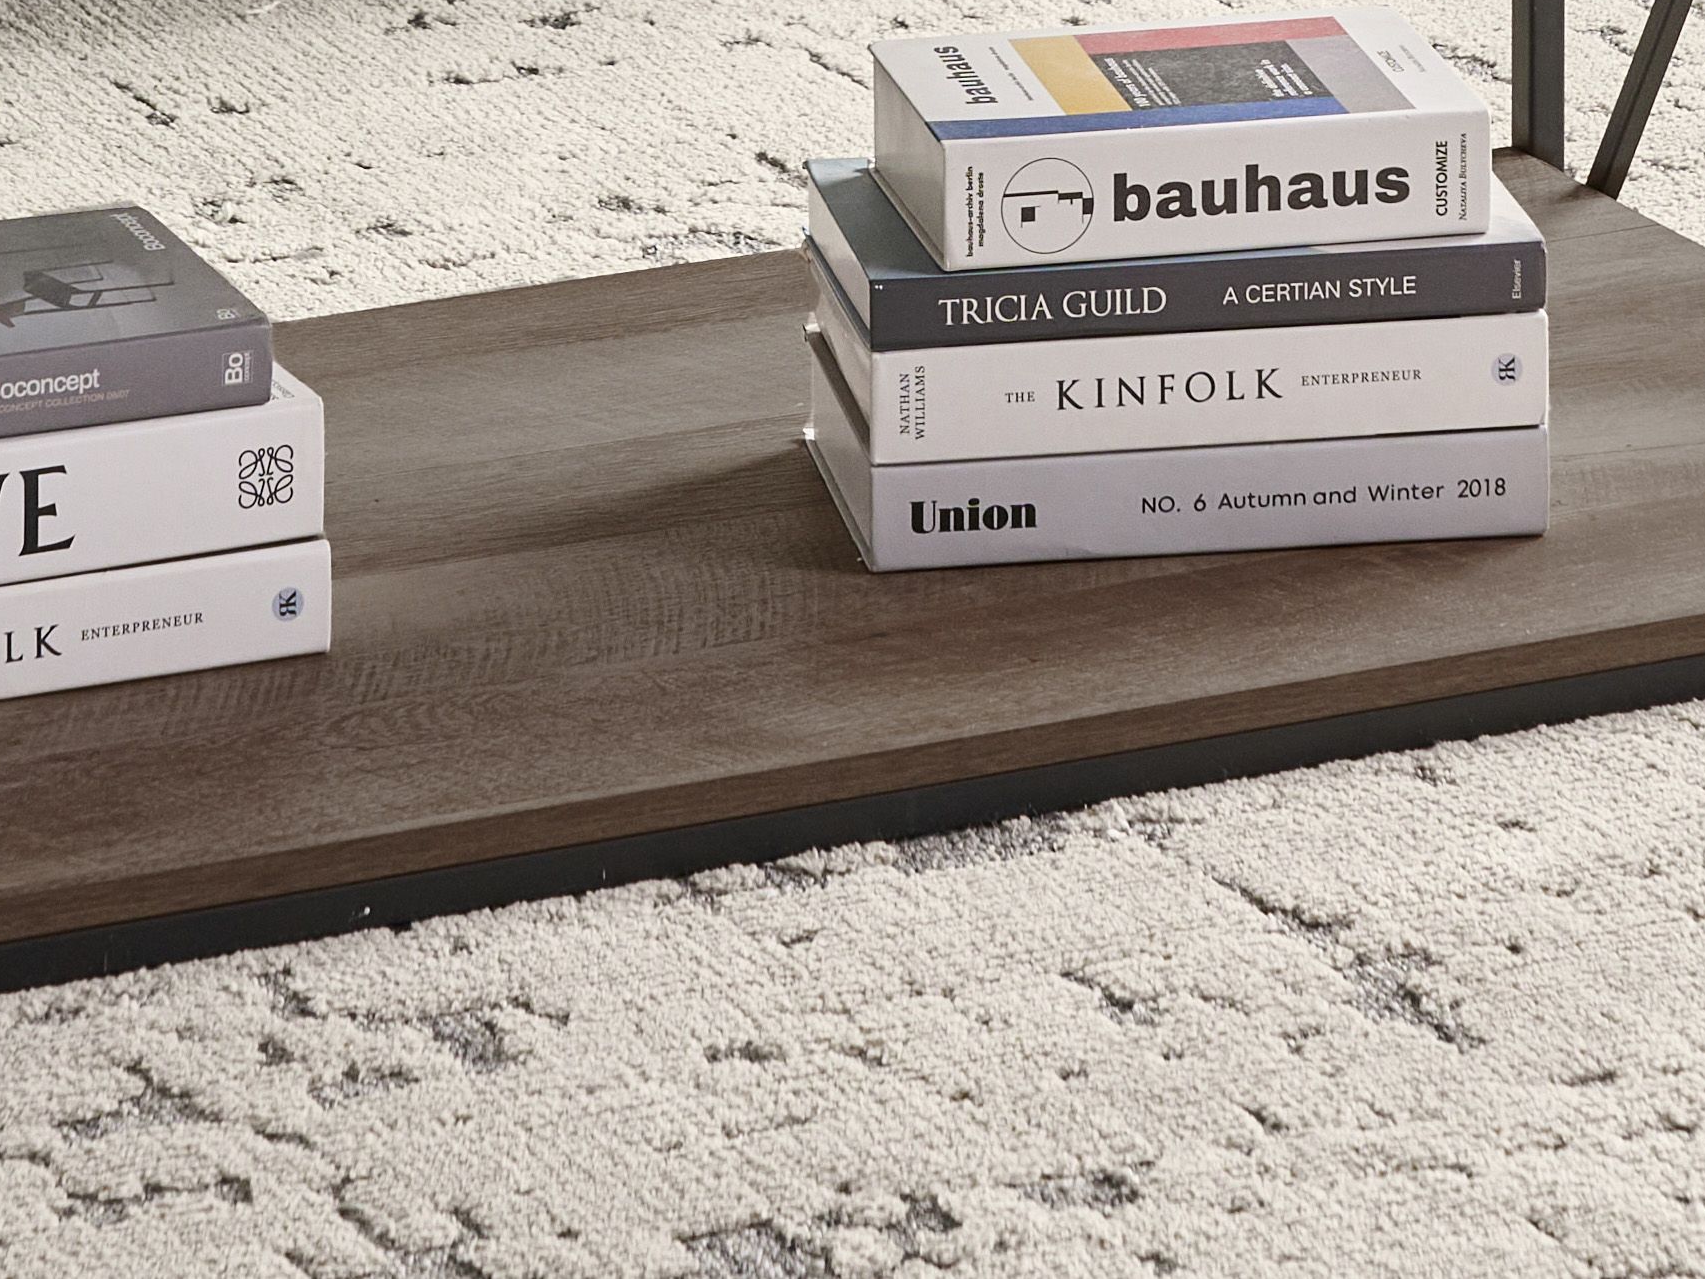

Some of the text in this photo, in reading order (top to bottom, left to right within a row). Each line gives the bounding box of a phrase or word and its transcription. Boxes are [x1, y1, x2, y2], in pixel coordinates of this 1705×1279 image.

[934, 46, 998, 105] bauhaus
[1113, 163, 1410, 222] bauhaus
[1435, 140, 1448, 217] CUSTOMIZE
[938, 286, 1167, 326] TRICIA GUILD
[1222, 275, 1416, 305] A CERTIAN STYLE
[224, 352, 244, 385] Bo
[45, 392, 105, 409] COLLECTION
[900, 372, 910, 435] NATHAN
[915, 365, 926, 440] WILLIAMS
[1005, 368, 1422, 411] THE KINFOLK ENTERPRENEUR
[910, 497, 1037, 534] Union
[1141, 477, 1506, 514] NO. 6 Autumn and Winter 2018
[81, 612, 204, 642] ENTERPRENEUR
